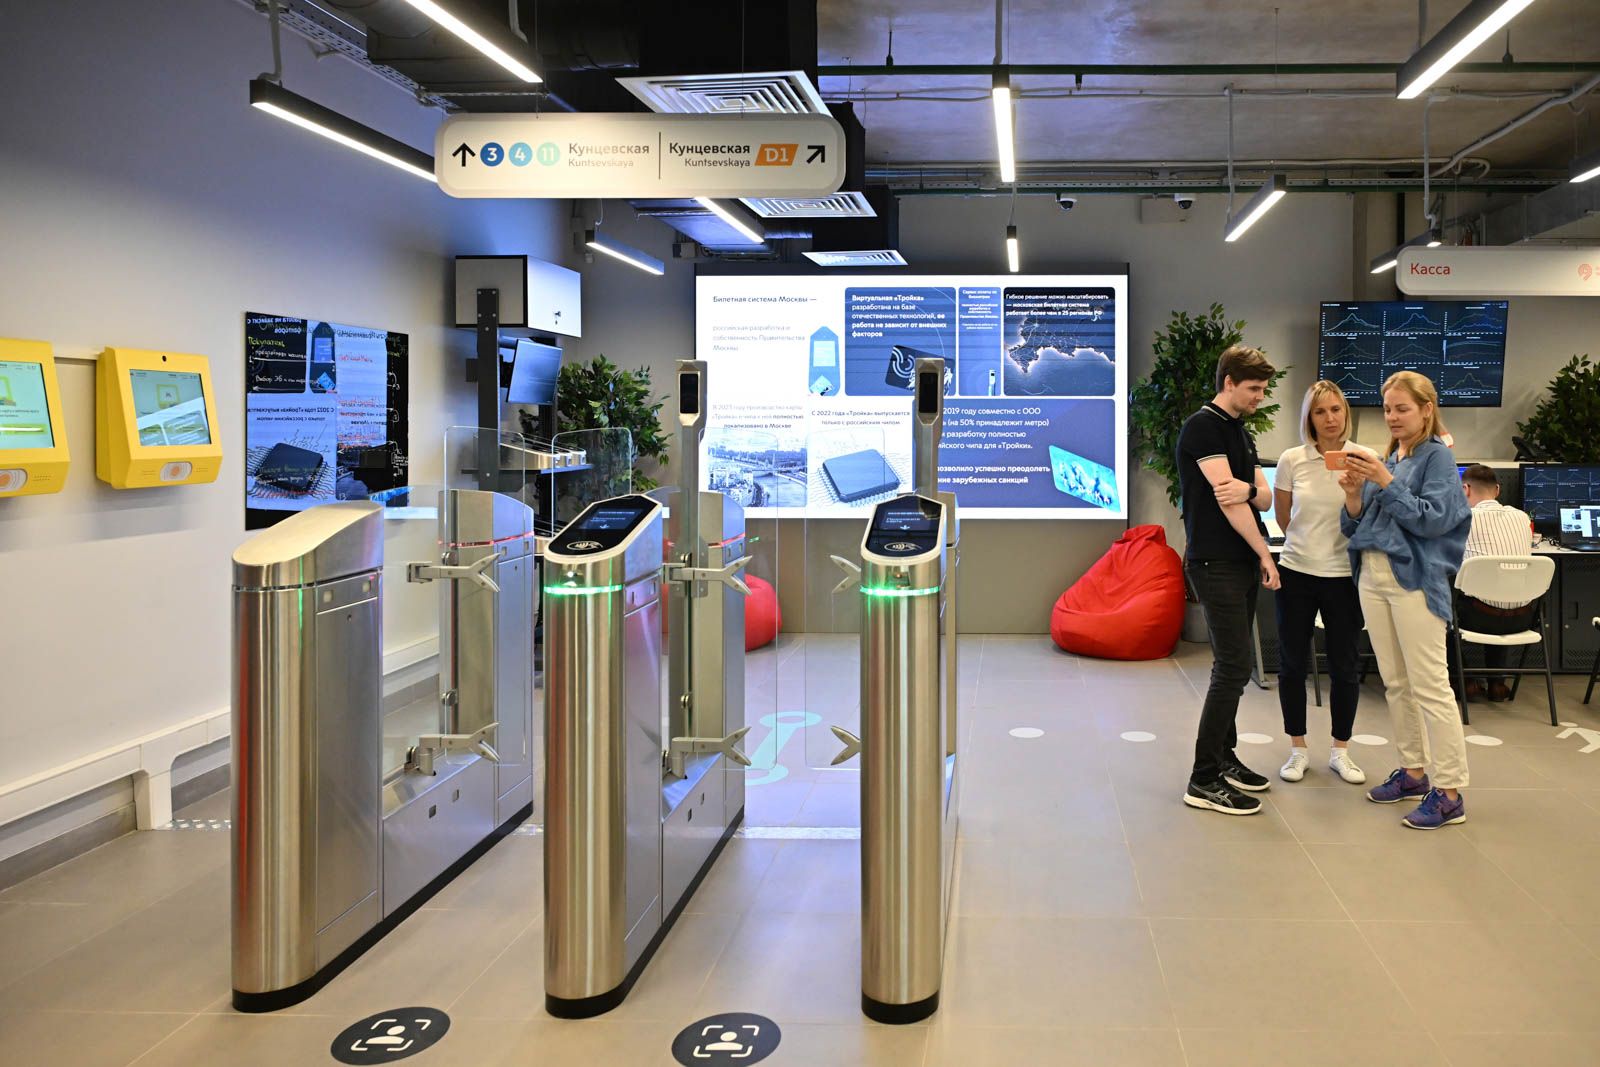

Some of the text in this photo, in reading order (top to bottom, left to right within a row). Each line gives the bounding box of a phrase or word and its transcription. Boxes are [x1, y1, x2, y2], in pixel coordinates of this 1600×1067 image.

[568, 143, 650, 157] Кунцевская
[669, 142, 751, 157] Кунцевская
[486, 147, 555, 162] 3 4 11
[765, 147, 790, 162] D1
[568, 158, 634, 168] Kuntsevskaya
[684, 158, 751, 168] Kuntsevskaya
[1410, 263, 1451, 275] Касса
[713, 295, 747, 303] Билетная
[778, 295, 808, 303] Москвы
[852, 294, 924, 303] Виртуальная «Тройка»
[852, 321, 875, 329] работа
[852, 330, 883, 338] факторов
[942, 407, 960, 415] 2019
[960, 408, 977, 416] году
[1022, 407, 1041, 415] ООО
[948, 418, 959, 427] (на
[959, 418, 975, 426] 50%
[975, 419, 1023, 427] принадлежит
[1024, 418, 1050, 427] метро)
[946, 430, 987, 439] разработку
[974, 465, 1006, 474] успешно
[1007, 465, 1051, 473] преодолеть
[952, 476, 998, 485] зарубежных
[998, 476, 1029, 485] санкций
